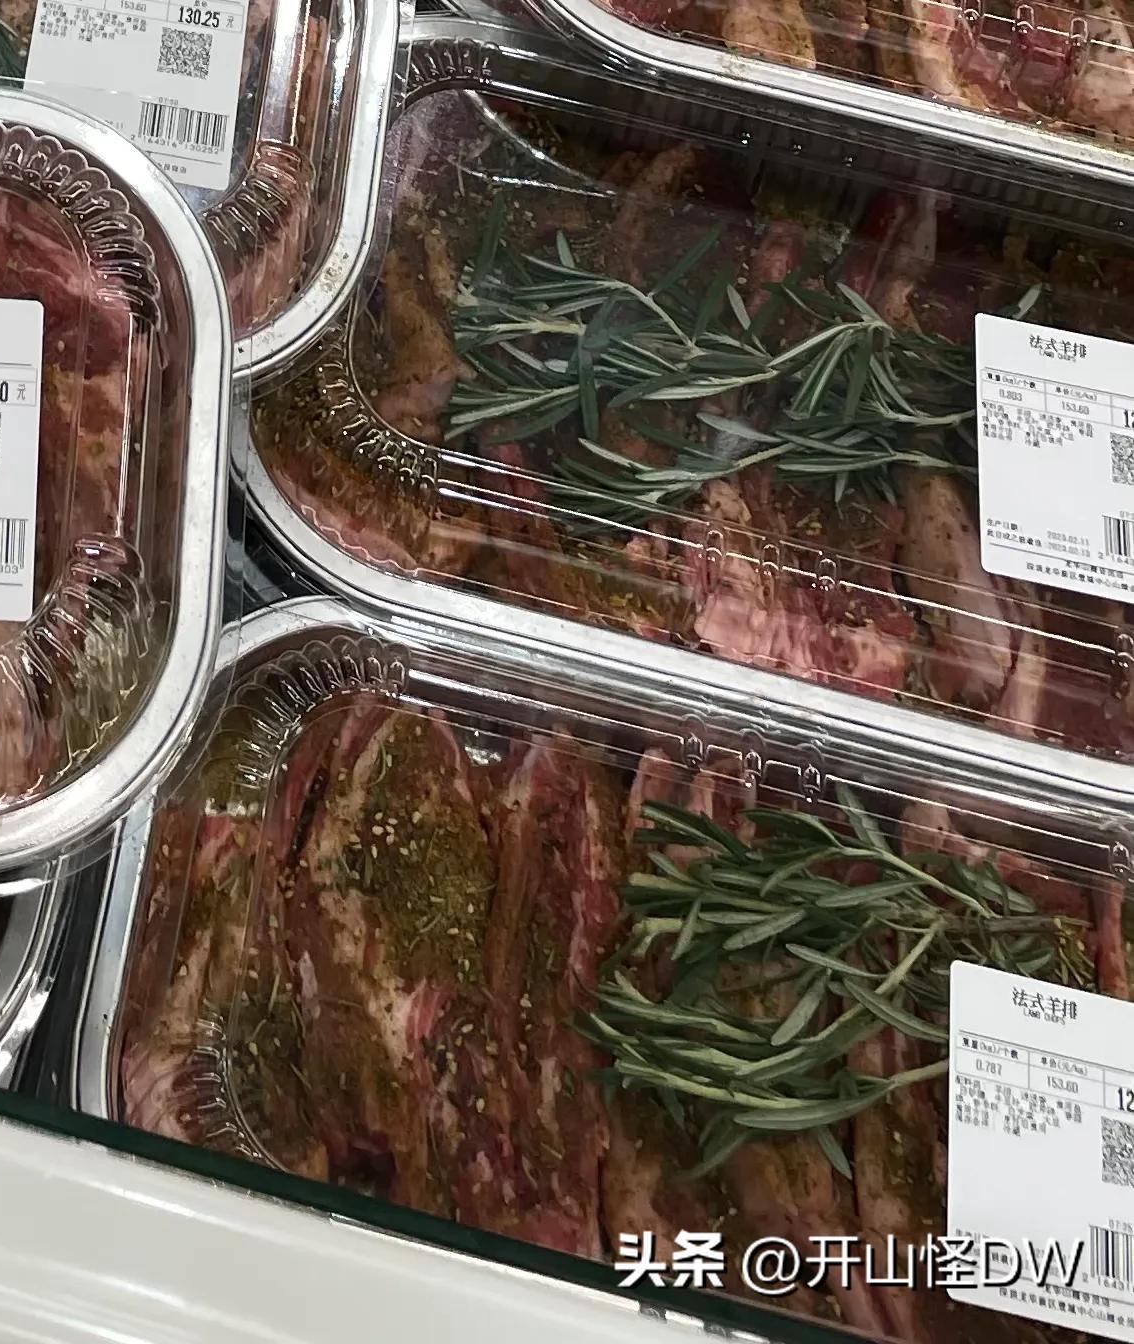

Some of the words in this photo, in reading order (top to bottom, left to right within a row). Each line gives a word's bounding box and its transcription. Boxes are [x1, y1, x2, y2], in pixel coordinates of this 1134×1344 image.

[177, 5, 221, 29] 130.25
[1028, 333, 1087, 359] 法式羊排
[1012, 986, 1078, 1020] 法式羊排
[1047, 1074, 1079, 1095] 153.60
